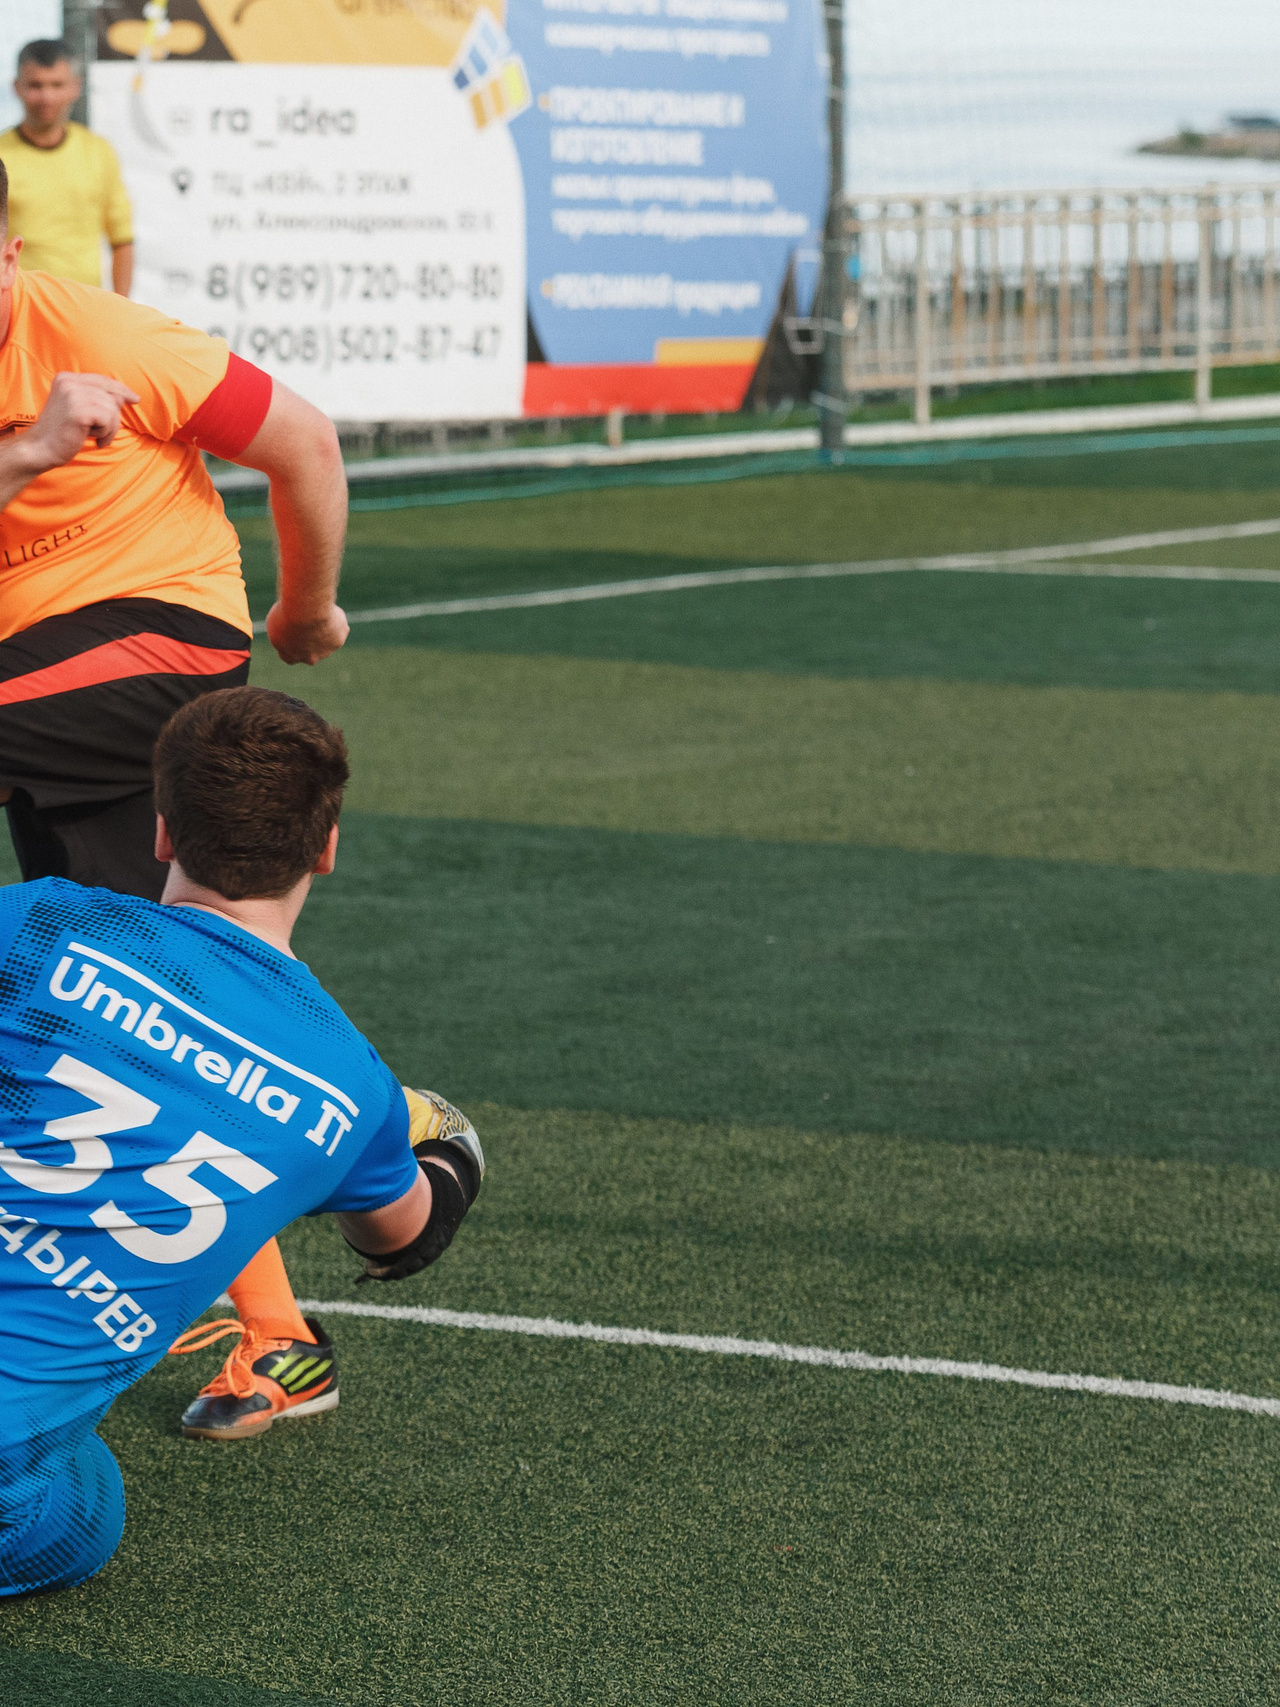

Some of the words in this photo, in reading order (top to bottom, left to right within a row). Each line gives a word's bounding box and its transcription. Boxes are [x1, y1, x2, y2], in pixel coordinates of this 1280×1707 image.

[209, 98, 358, 148] ra_idea
[206, 262, 504, 311] 8(989)720-80-80
[4, 524, 87, 567] LIGHT
[49, 955, 301, 1125] Umbrella
[305, 1099, 354, 1157] IT
